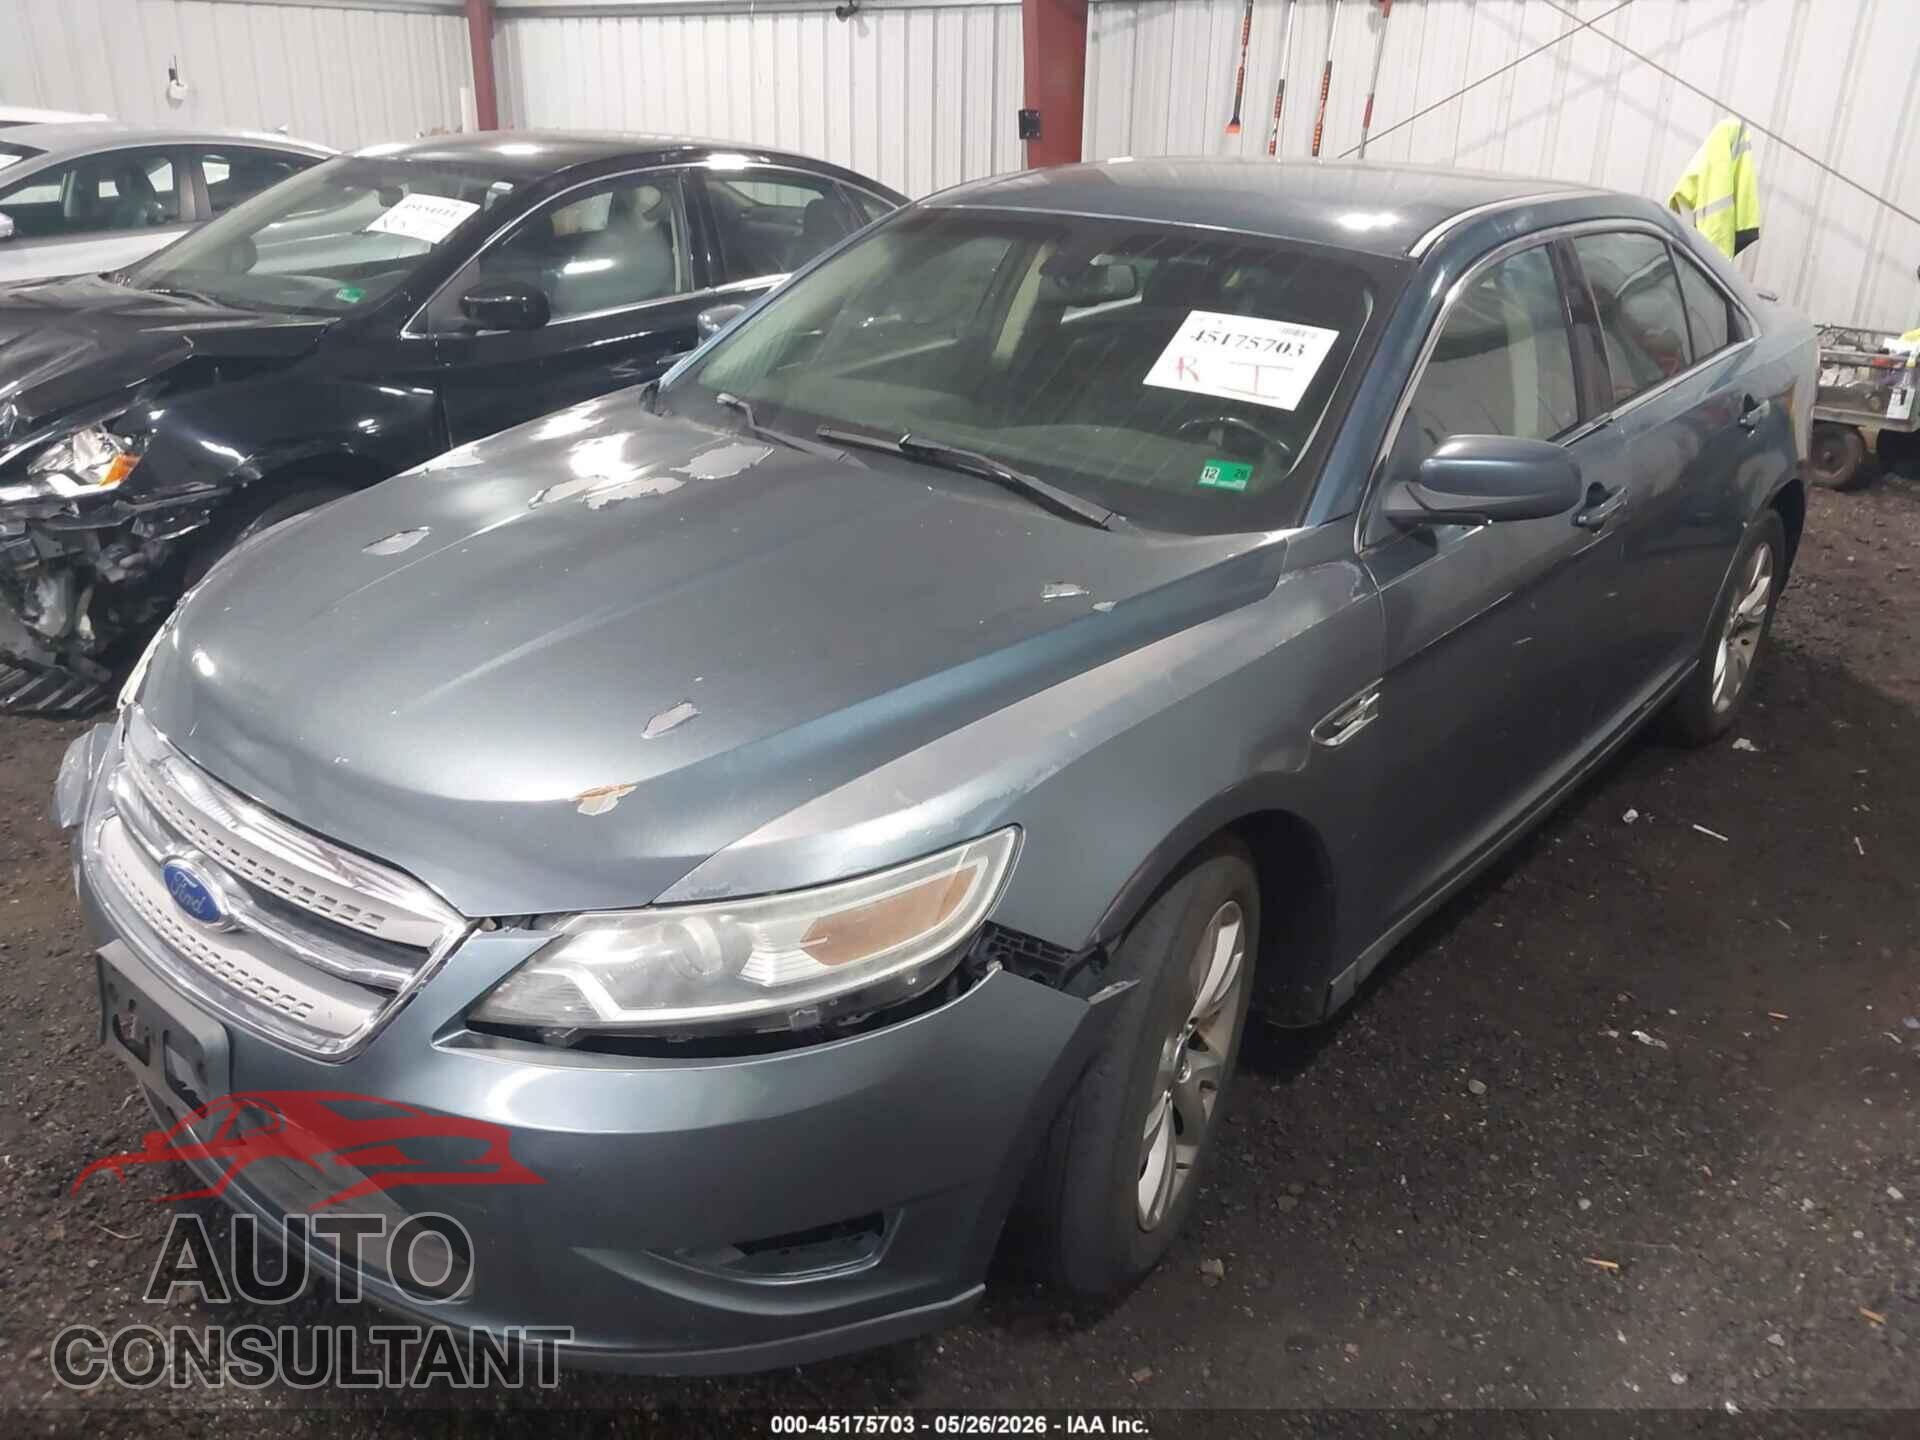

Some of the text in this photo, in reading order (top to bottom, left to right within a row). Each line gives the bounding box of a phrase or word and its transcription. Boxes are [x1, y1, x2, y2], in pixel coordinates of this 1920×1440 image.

[1189, 328, 1306, 358] 45175703
[1175, 355, 1200, 383] R
[169, 870, 208, 916] Ford
